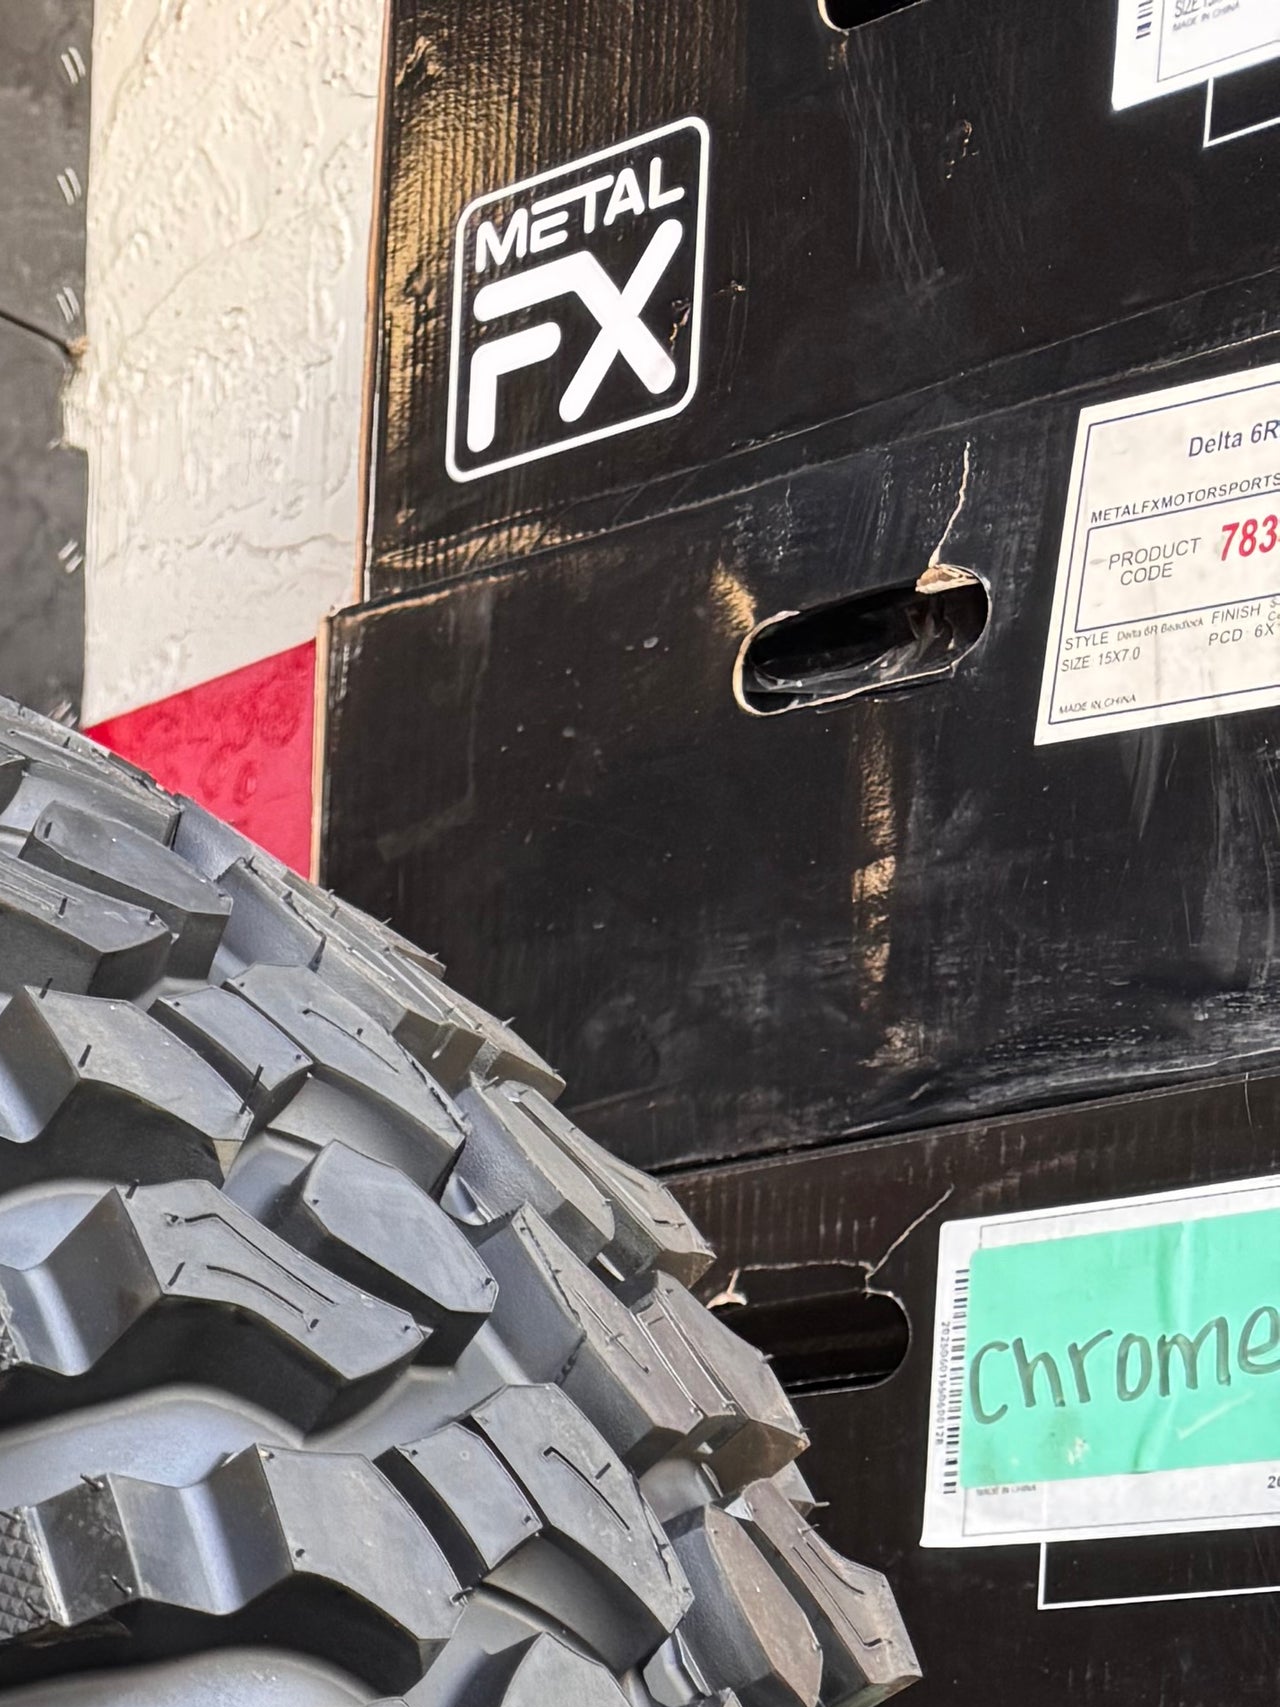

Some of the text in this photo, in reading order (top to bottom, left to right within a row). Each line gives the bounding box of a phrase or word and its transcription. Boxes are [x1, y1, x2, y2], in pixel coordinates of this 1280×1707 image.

[476, 156, 685, 273] METAL
[467, 218, 684, 452] FX
[1189, 431, 1243, 458] Delta
[1109, 513, 1280, 571] PRODUCT 783
[1120, 562, 1174, 586] CODE
[1065, 631, 1109, 651] STYLE
[1211, 603, 1261, 625] FINISH
[1104, 695, 1136, 708] CHINA
[969, 1306, 1280, 1425] Chrome
